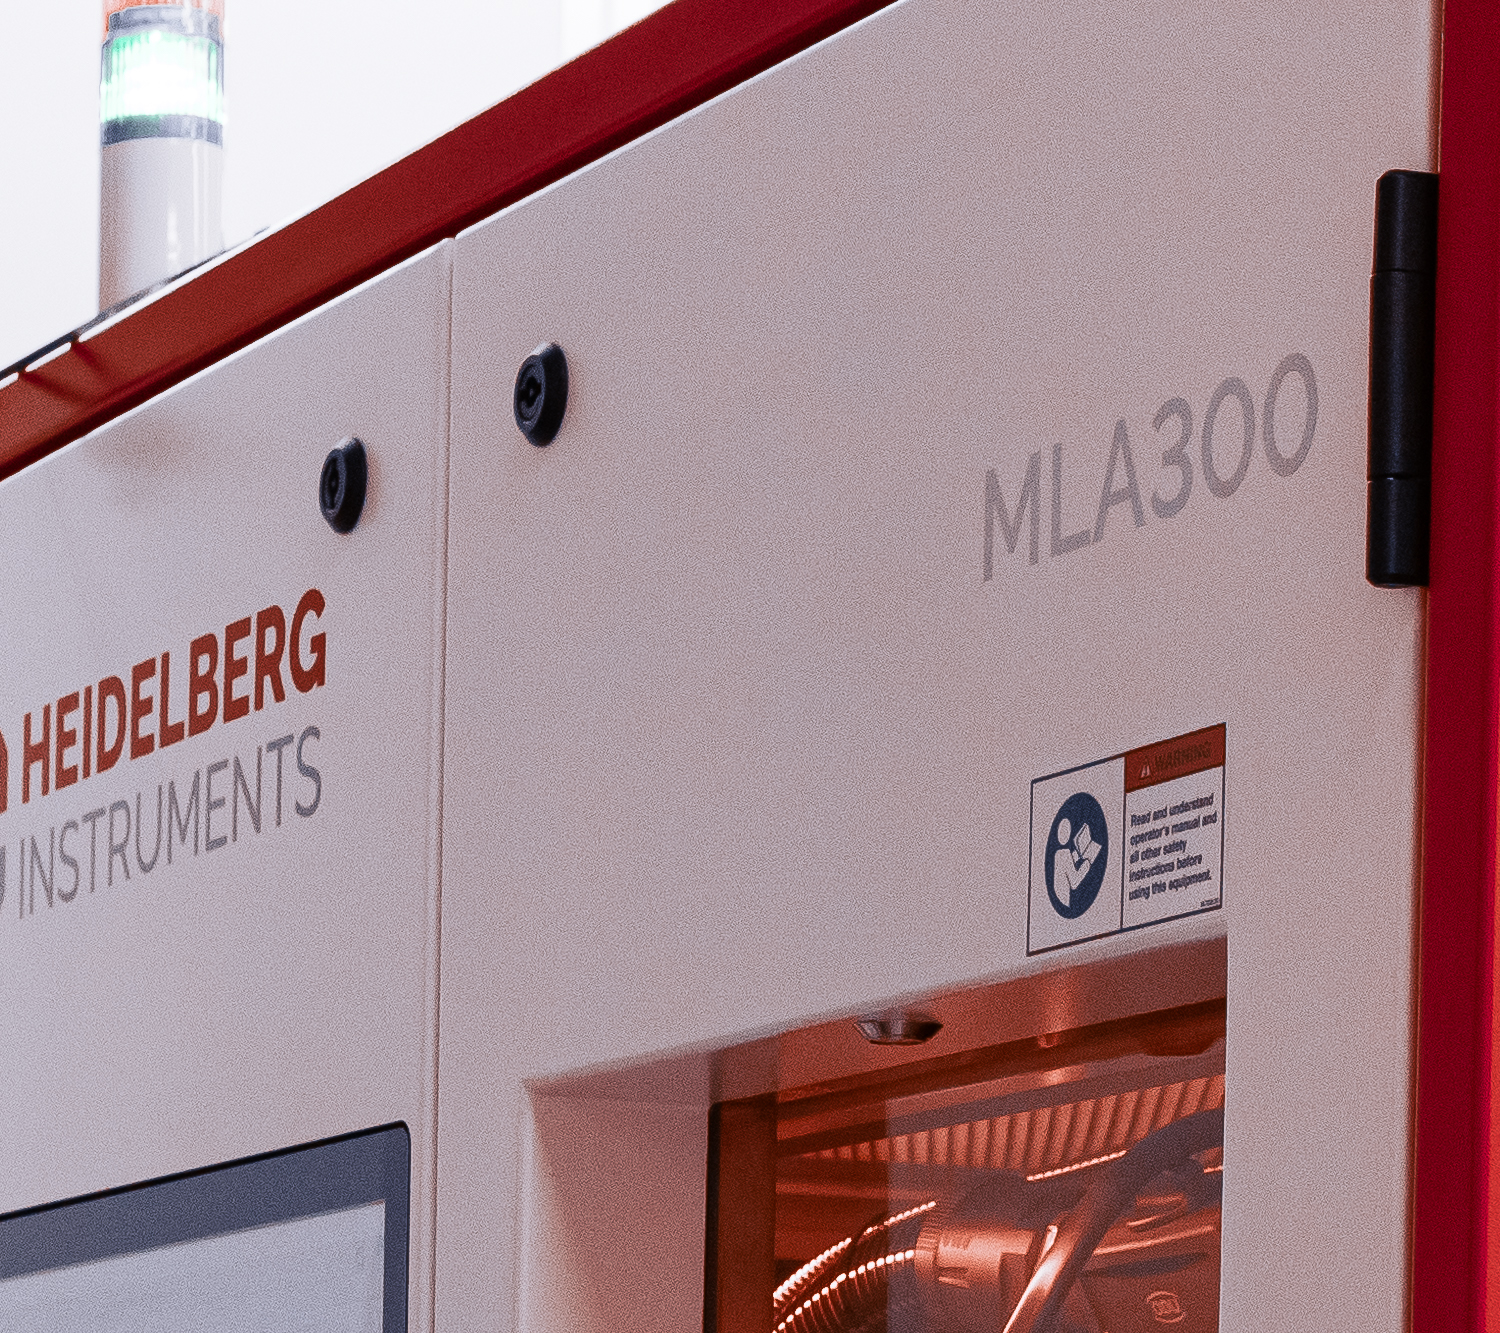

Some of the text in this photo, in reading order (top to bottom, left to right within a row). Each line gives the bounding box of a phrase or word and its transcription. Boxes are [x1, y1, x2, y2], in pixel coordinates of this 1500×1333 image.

[981, 352, 1319, 582] MLA300
[22, 588, 328, 804] HEIDELBERG
[1154, 741, 1211, 769] WARNING
[18, 725, 322, 919] INSTRUMENTS
[1130, 793, 1214, 827] Read and understand
[1130, 812, 1217, 846] operator's manual and
[1129, 853, 1202, 882] instructions before
[1130, 839, 1187, 864] all other safety
[1129, 870, 1211, 901] using this equipment.
